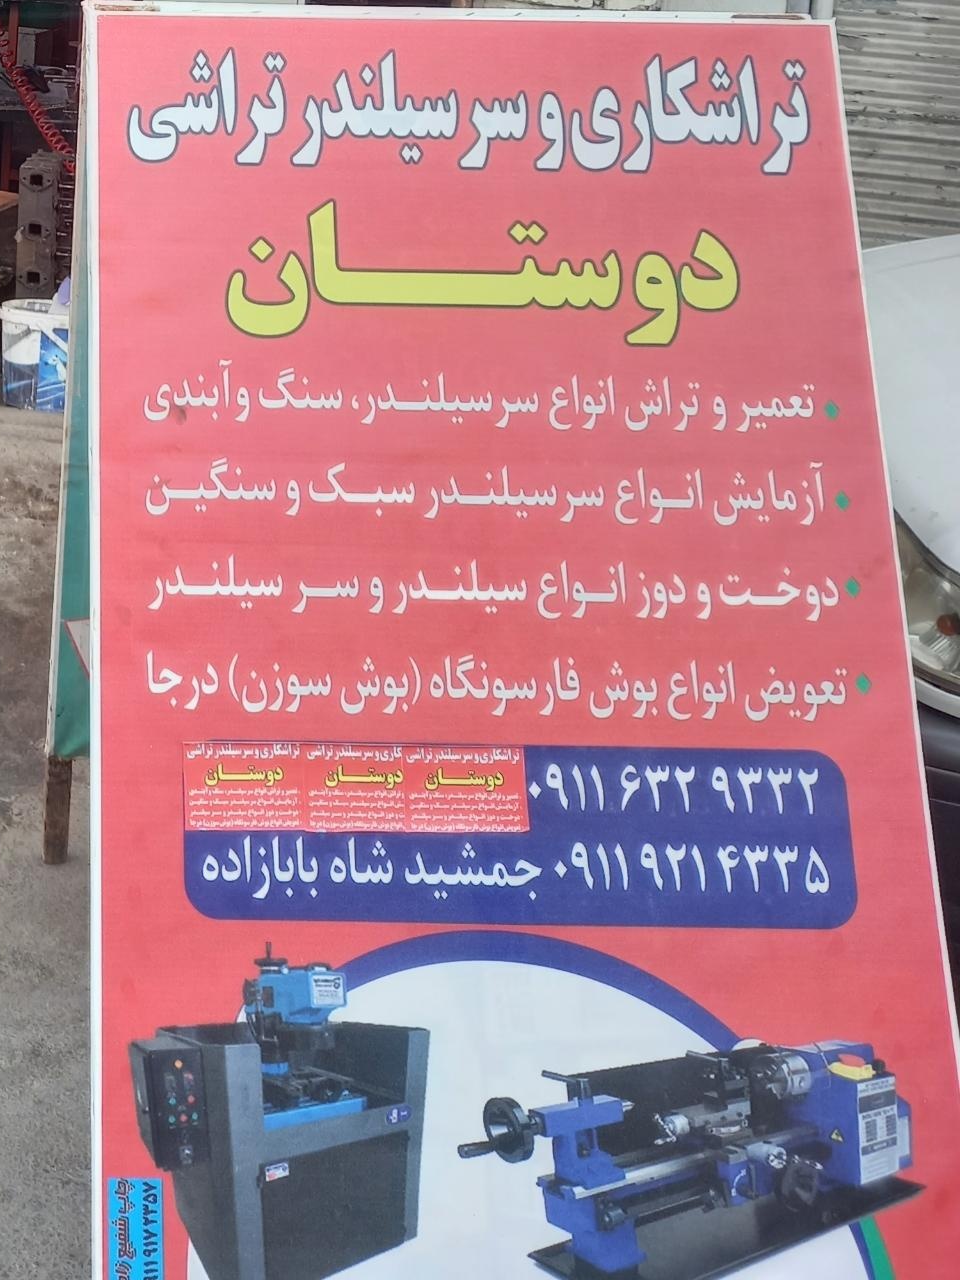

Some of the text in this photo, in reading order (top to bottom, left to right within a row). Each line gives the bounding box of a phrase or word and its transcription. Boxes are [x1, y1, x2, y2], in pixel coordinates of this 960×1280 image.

[127, 47, 287, 166] تراشی
[534, 91, 566, 171] و
[569, 52, 810, 176] تراشکاری
[226, 199, 740, 347] دوستان
[257, 366, 344, 411] سنگ
[548, 373, 616, 431] انواع
[624, 376, 701, 432] تراش
[712, 394, 728, 432] و
[734, 382, 816, 433] تعمیر
[144, 456, 277, 516] سنگین
[285, 478, 302, 517] و
[307, 461, 416, 518] سبک
[614, 466, 704, 526] انواع
[713, 461, 825, 527] آزمایش
[146, 553, 840, 623] دوخت و دوز انواع سیلندر و سر سیلندر
[589, 660, 659, 720] بوش
[667, 660, 737, 721] انواع
[744, 664, 848, 723] تعویض
[204, 762, 284, 787] دوستان
[324, 764, 404, 790] دوستان
[424, 767, 505, 792] دوستان
[528, 763, 819, 815] ۰۹۱۱ ۶۳۲ ۹۳۳۲
[329, 836, 394, 884] شاه
[404, 841, 542, 901] جمشید
[716, 845, 830, 894] ۴۳۳۵
[114, 1177, 135, 1214] چاپ
